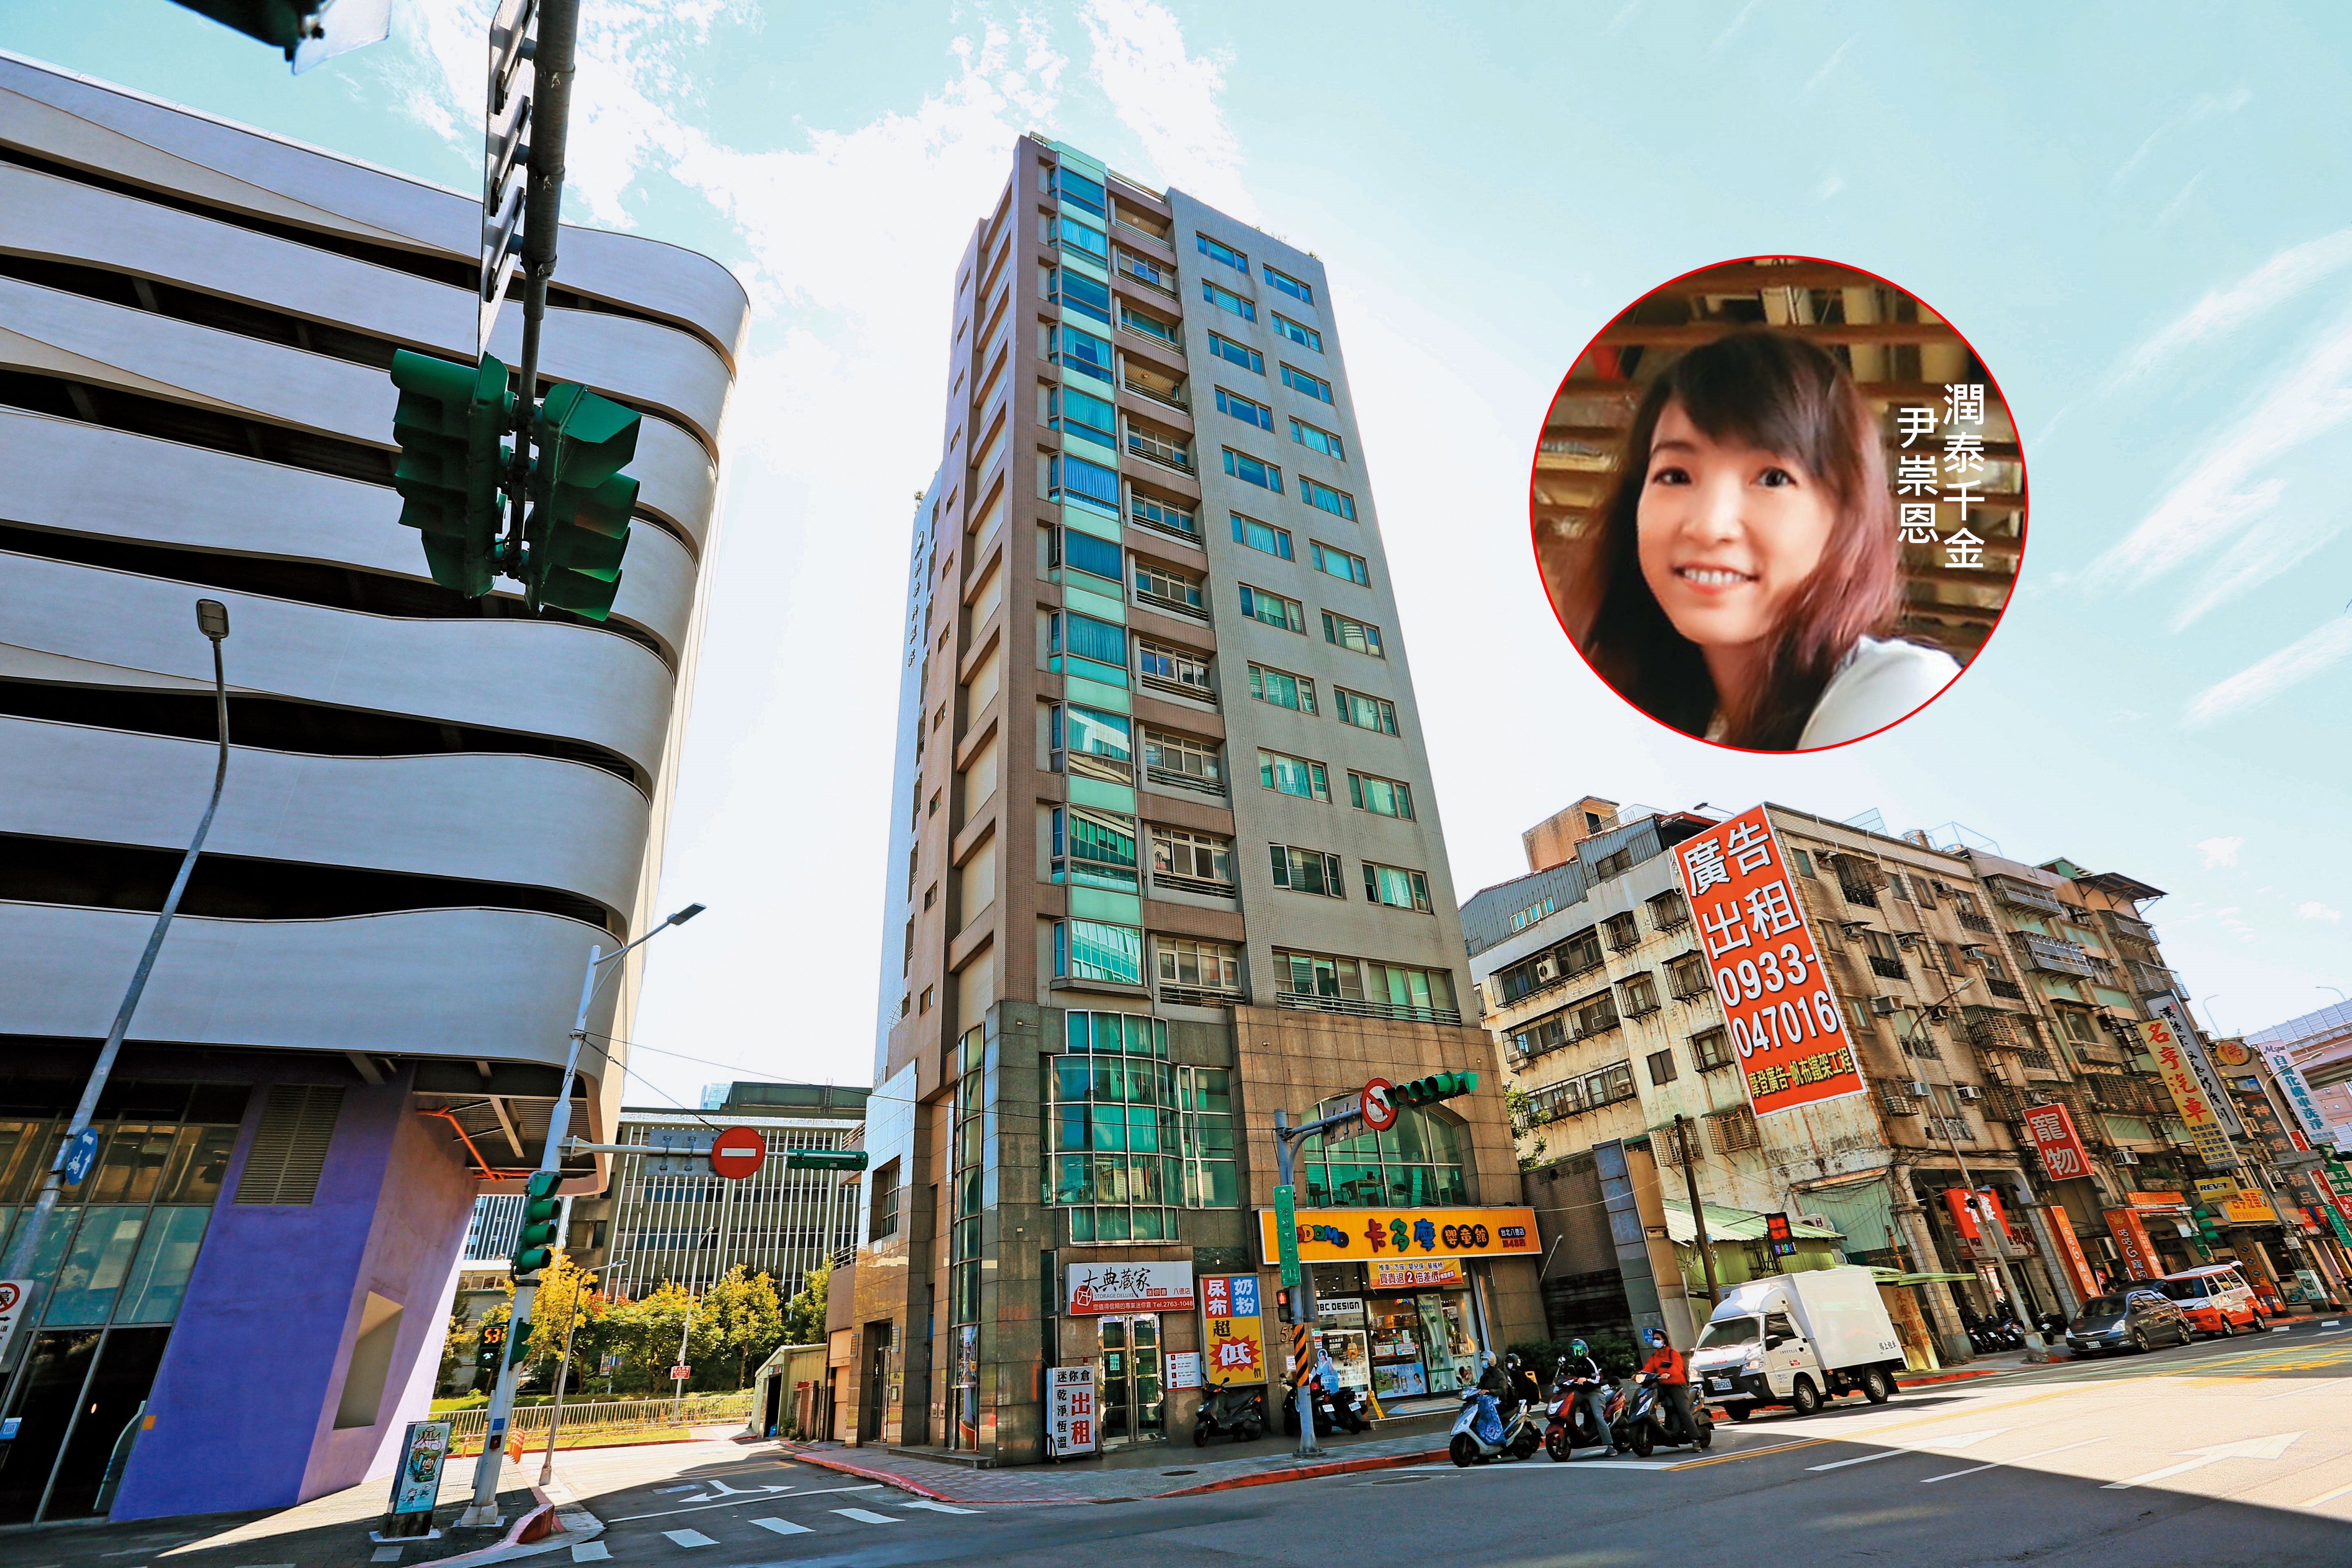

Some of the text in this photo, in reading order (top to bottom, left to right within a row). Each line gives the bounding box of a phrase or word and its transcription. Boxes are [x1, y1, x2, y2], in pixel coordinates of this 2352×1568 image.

[1683, 820, 1773, 897] 廣告
[1702, 880, 1801, 961] 出租
[1715, 942, 1816, 1008] 0933-
[1731, 989, 1838, 1059] 047016
[2031, 1113, 2080, 1176] 寵物
[1364, 1218, 1436, 1252] 卡多摩
[1207, 1280, 1227, 1316] 尿布
[1234, 1278, 1254, 1314] 奶粉
[1332, 1301, 1360, 1311] DESIGN
[484, 1327, 502, 1344] 53
[1057, 1370, 1090, 1383] 迷你倉
[1071, 1392, 1091, 1445] 出租
